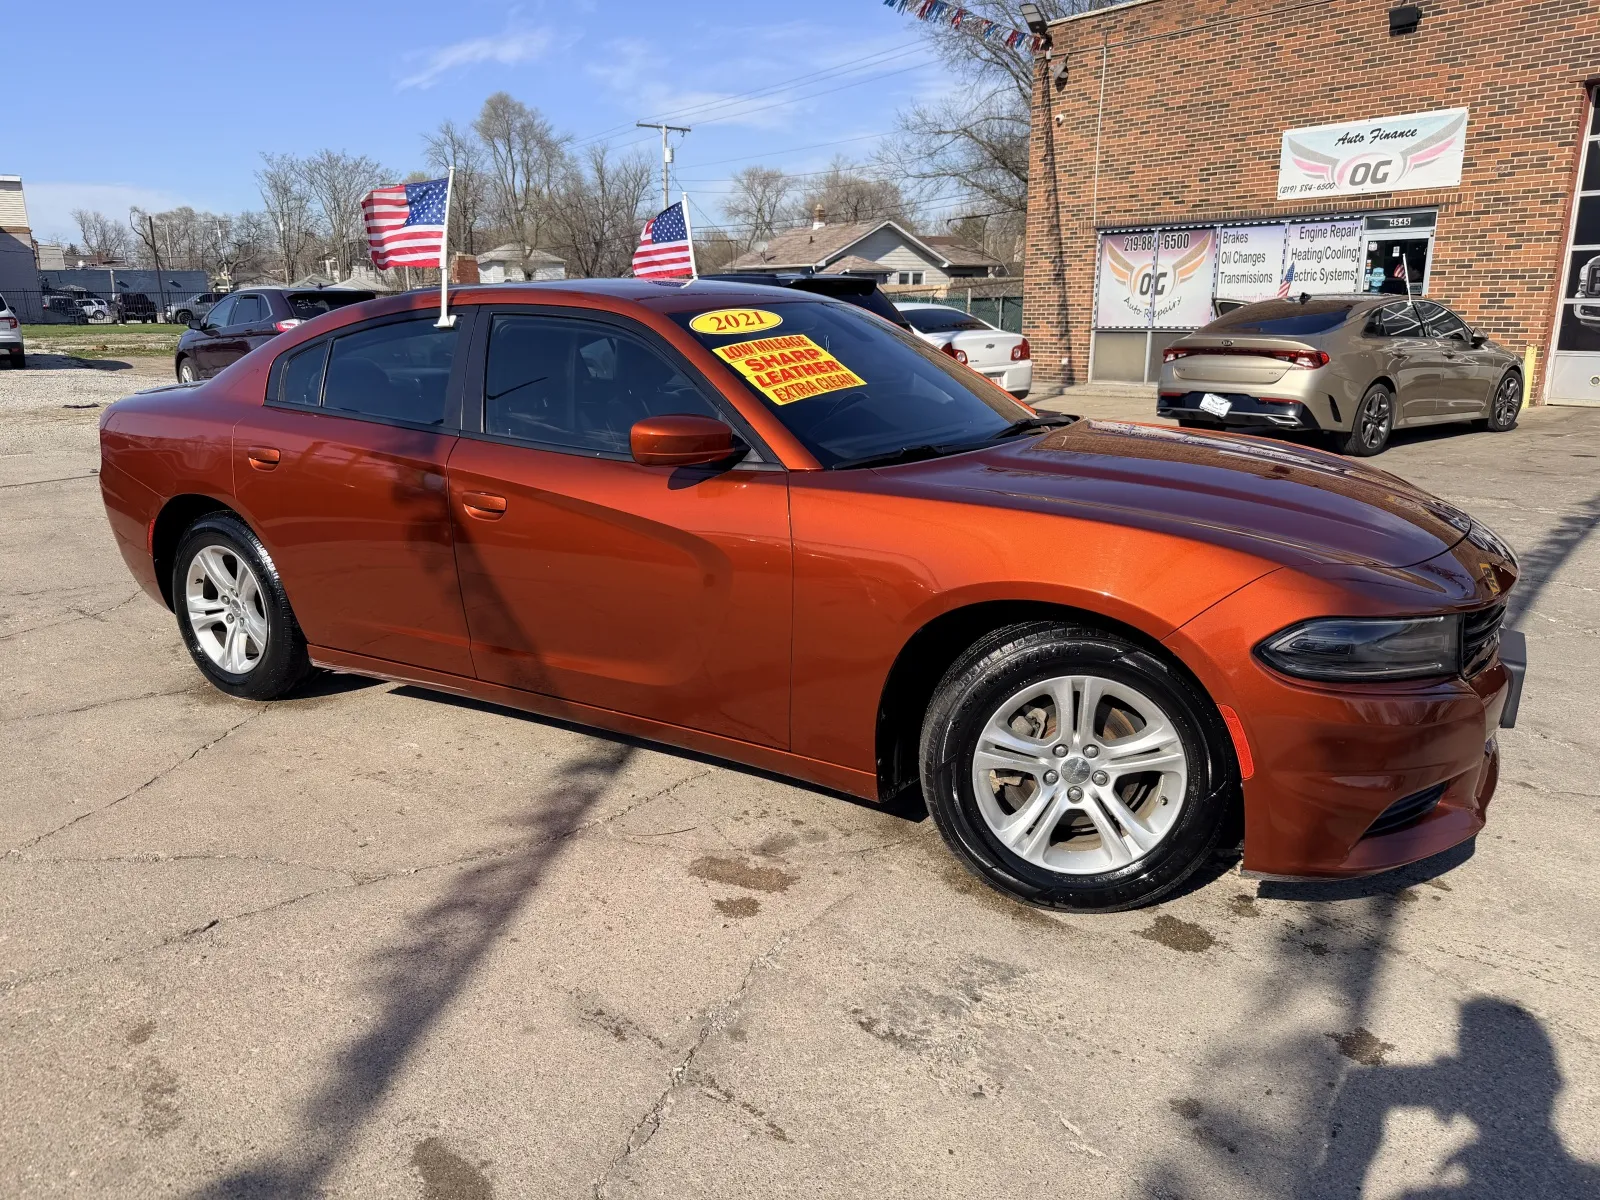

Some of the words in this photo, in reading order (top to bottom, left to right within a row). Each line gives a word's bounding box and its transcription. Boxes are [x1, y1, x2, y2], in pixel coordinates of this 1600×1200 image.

[1334, 132, 1365, 147] Auto
[1369, 128, 1418, 145] Finance
[1349, 160, 1392, 186] OG
[1279, 185, 1298, 194] (219)
[1299, 182, 1336, 193] 884-6500
[1390, 218, 1411, 227] 4545
[1222, 230, 1249, 244] Brakes
[1299, 226, 1328, 242] Engine
[1329, 223, 1358, 241] Repair
[1221, 251, 1232, 265] Oil
[1232, 250, 1266, 267] Changes
[1290, 245, 1358, 264] Heating/Cooling
[1139, 272, 1167, 295] OG
[1219, 270, 1273, 285] Transmissions
[1293, 268, 1318, 282] ectric
[1319, 267, 1356, 285] Systems
[1123, 296, 1142, 316] Auto
[709, 311, 767, 331] 2021
[721, 343, 753, 359] LOW
[753, 335, 811, 353] MILEAGE
[744, 348, 821, 372] SHARP
[754, 360, 842, 388] LEATHER
[772, 380, 818, 402] EXTRA
[817, 372, 858, 389] CLEAN
